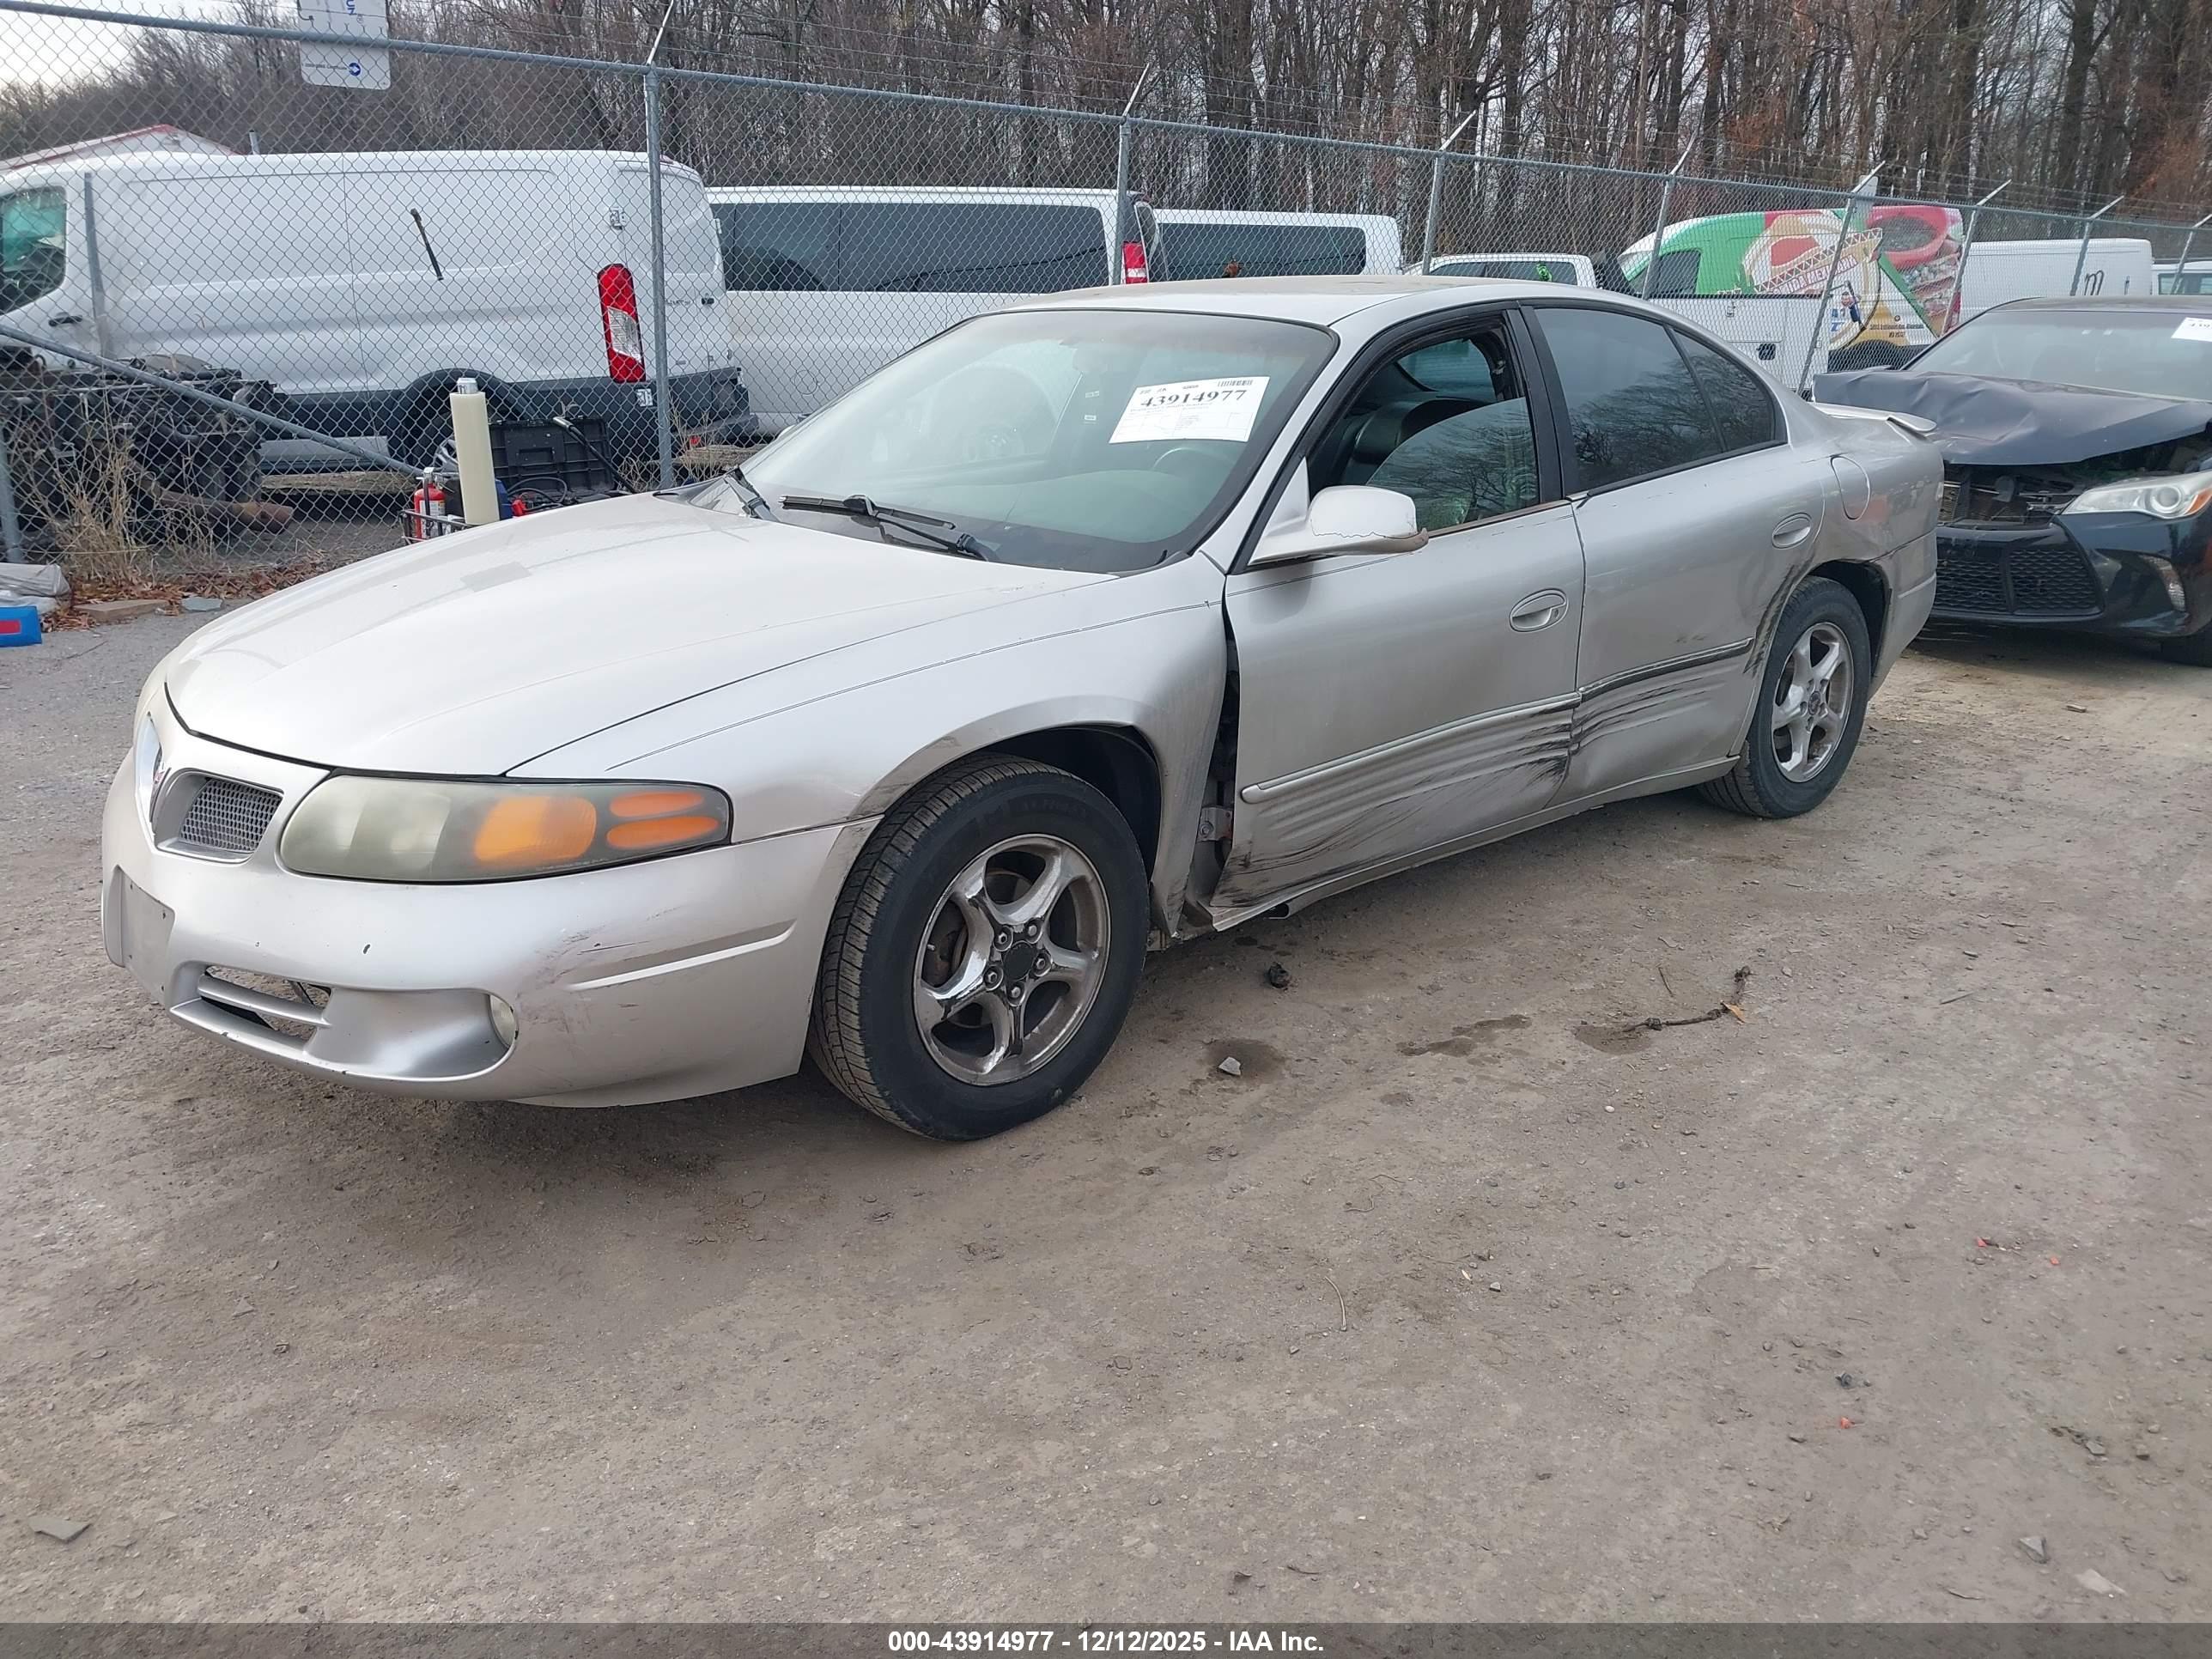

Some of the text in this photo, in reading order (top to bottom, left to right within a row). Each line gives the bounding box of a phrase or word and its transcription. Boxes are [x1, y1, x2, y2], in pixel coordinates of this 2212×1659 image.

[1768, 254, 1857, 295] OMIDA MEXIANA
[1140, 389, 1248, 408] 43914977
